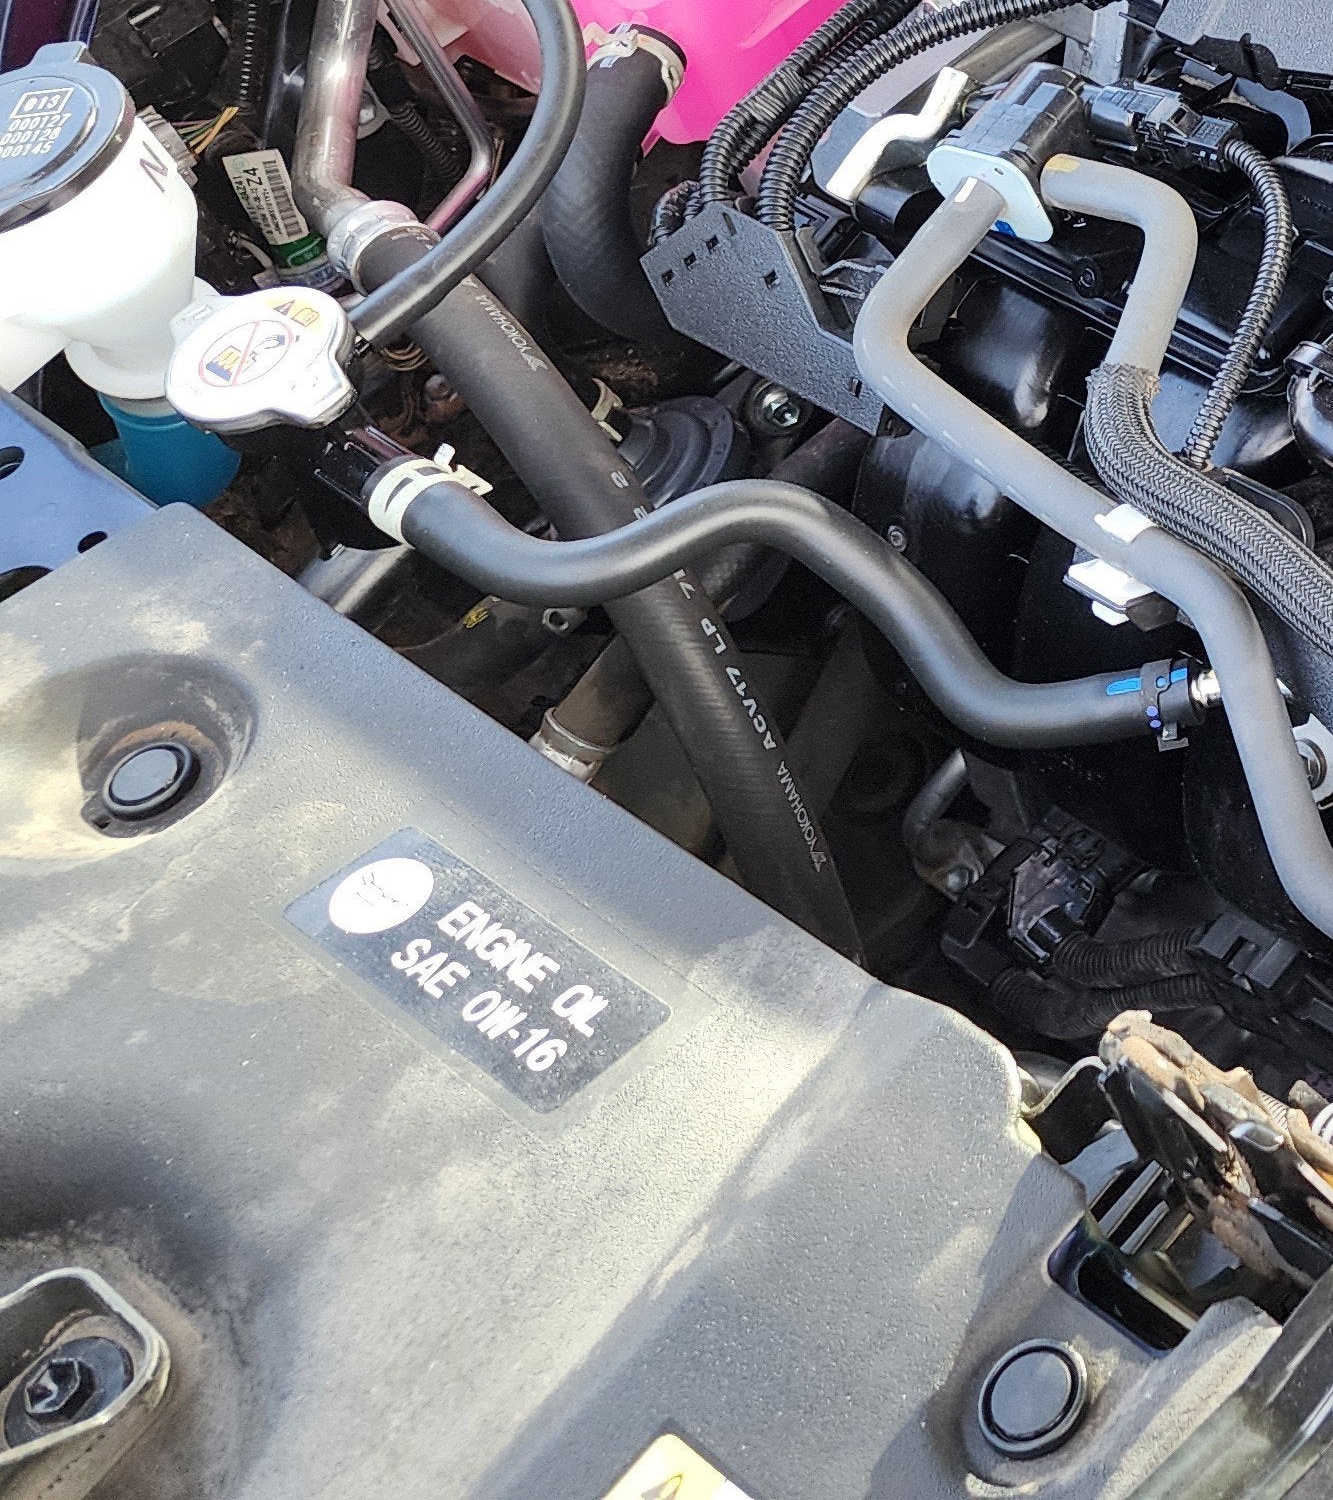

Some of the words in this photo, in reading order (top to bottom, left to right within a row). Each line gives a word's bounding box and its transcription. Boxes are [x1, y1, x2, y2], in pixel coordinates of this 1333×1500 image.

[243, 167, 263, 187] Z4
[700, 617, 727, 655] LP
[726, 664, 778, 751] ACV17
[776, 759, 820, 852] YOKOHAMA
[437, 901, 560, 993] ENGINE
[391, 938, 470, 999] SAE
[462, 990, 568, 1072] 0W-16
